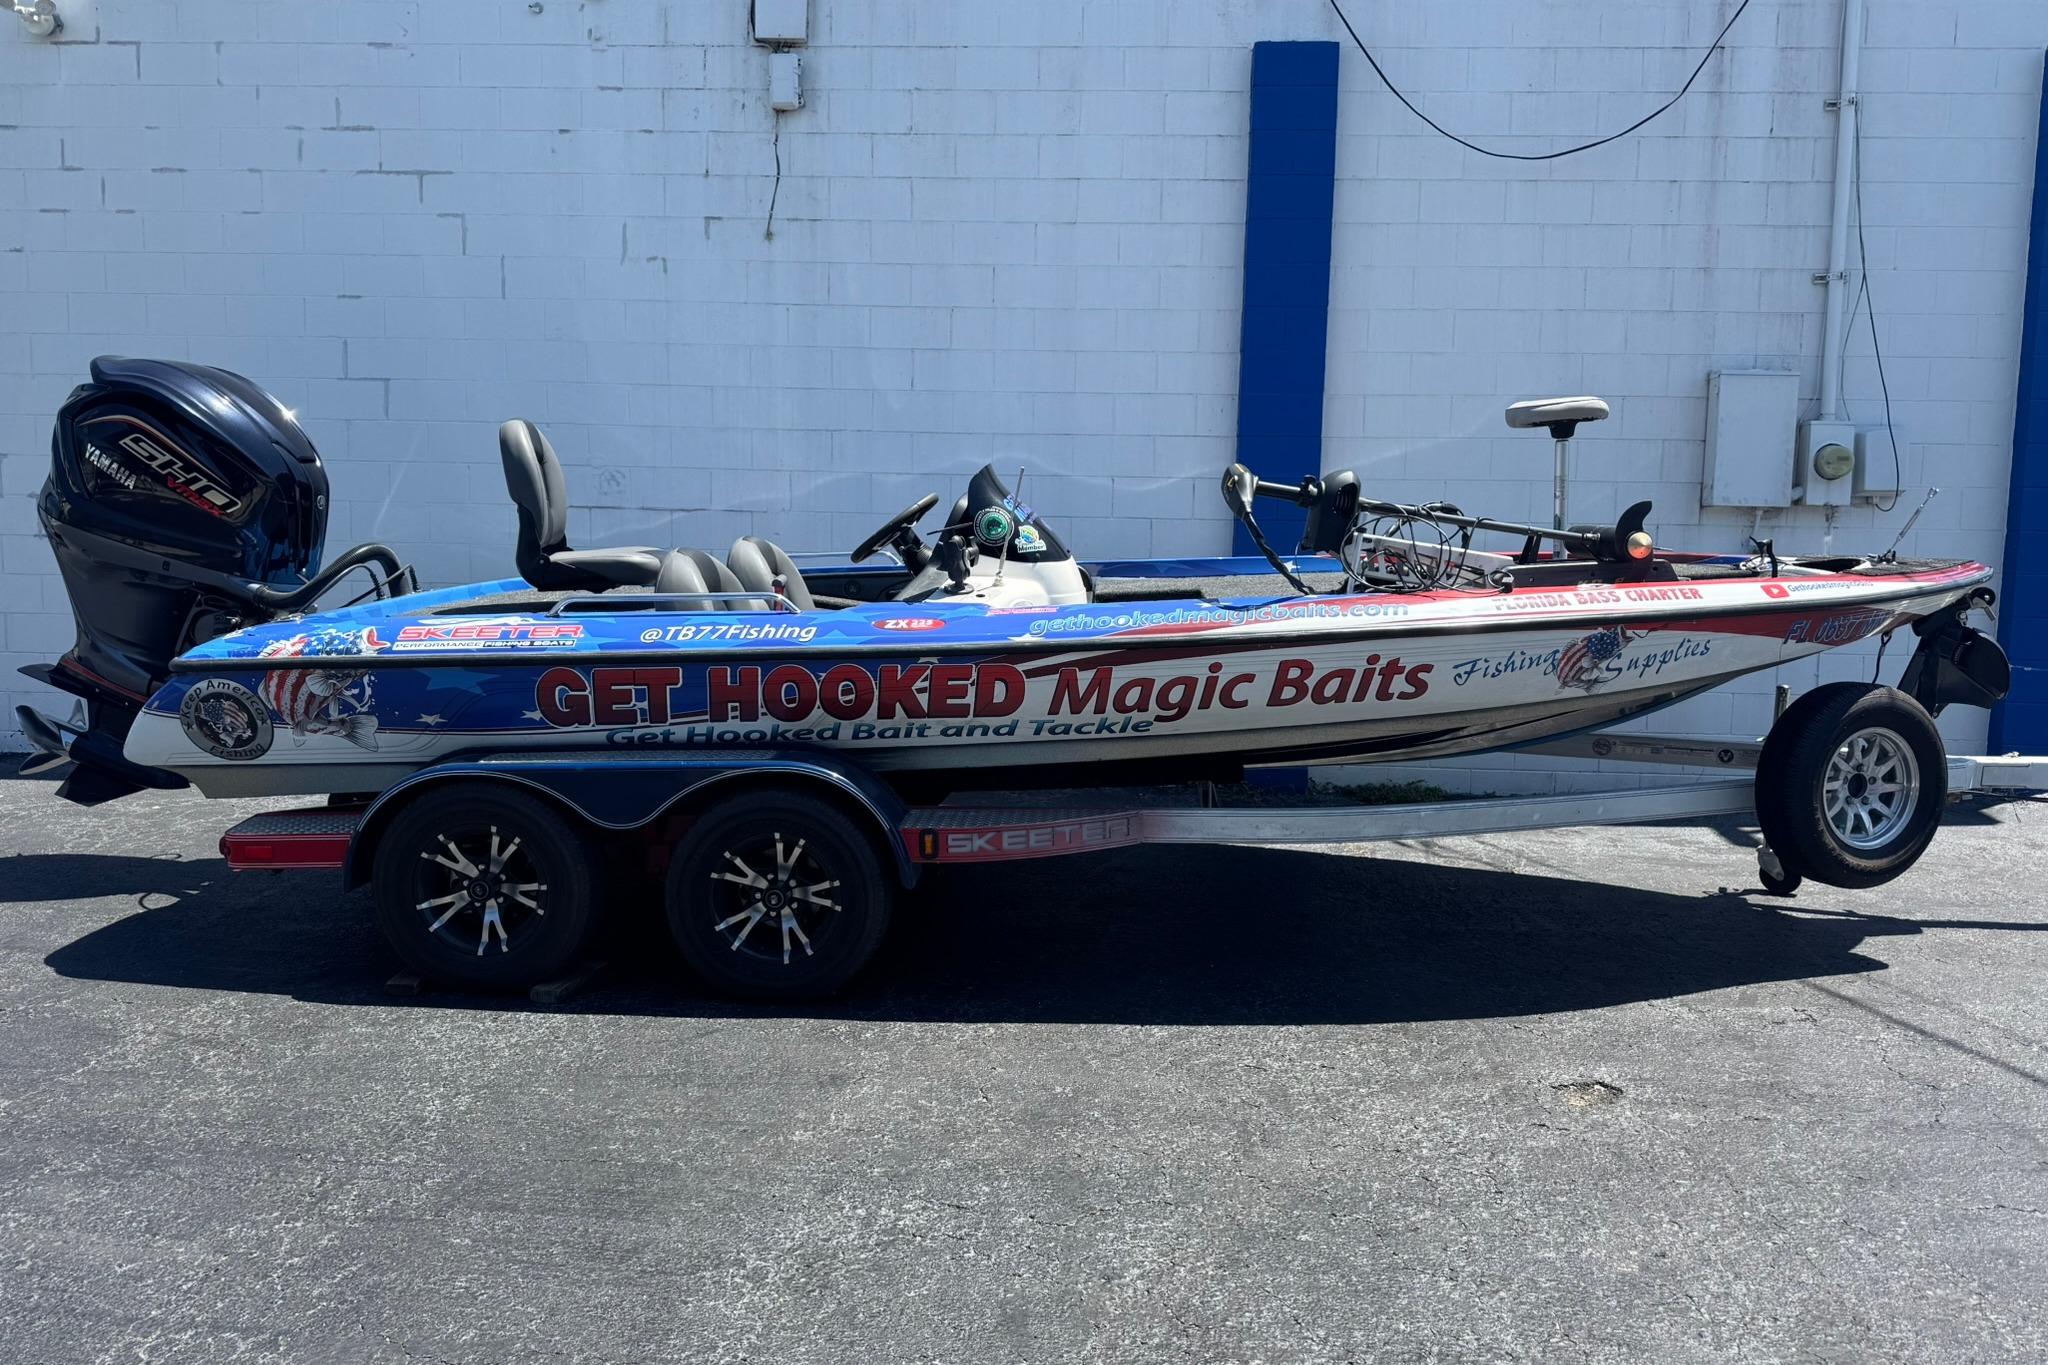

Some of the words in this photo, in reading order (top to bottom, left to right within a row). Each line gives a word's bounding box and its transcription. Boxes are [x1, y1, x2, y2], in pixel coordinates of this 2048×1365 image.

[85, 443, 137, 490] YAMAHA
[118, 433, 242, 513] SHO
[1492, 594, 1572, 610] FLORIDA
[1574, 591, 1621, 605] BASS
[1623, 587, 1704, 602] CHARTER
[398, 625, 584, 640] SKEETER
[640, 623, 817, 643] @TB77Fishing
[884, 619, 909, 629] ZX
[1029, 604, 1409, 635] gethookedmagicbaits.com
[1453, 648, 1561, 686] Fishing
[1597, 637, 1712, 684] Supplies
[181, 687, 202, 719] Keep
[206, 679, 265, 720] America
[535, 667, 682, 728] GET
[707, 663, 1027, 722] HOOKED
[1047, 662, 1257, 723] Magic
[1266, 653, 1435, 708] Baits
[606, 728, 676, 745] Get
[687, 722, 841, 746] Hooked
[851, 721, 932, 741] Bait
[939, 719, 1020, 738] and
[1028, 716, 1155, 737] Tackle
[210, 743, 264, 758] Fishing
[947, 817, 1131, 853] SKEETER
